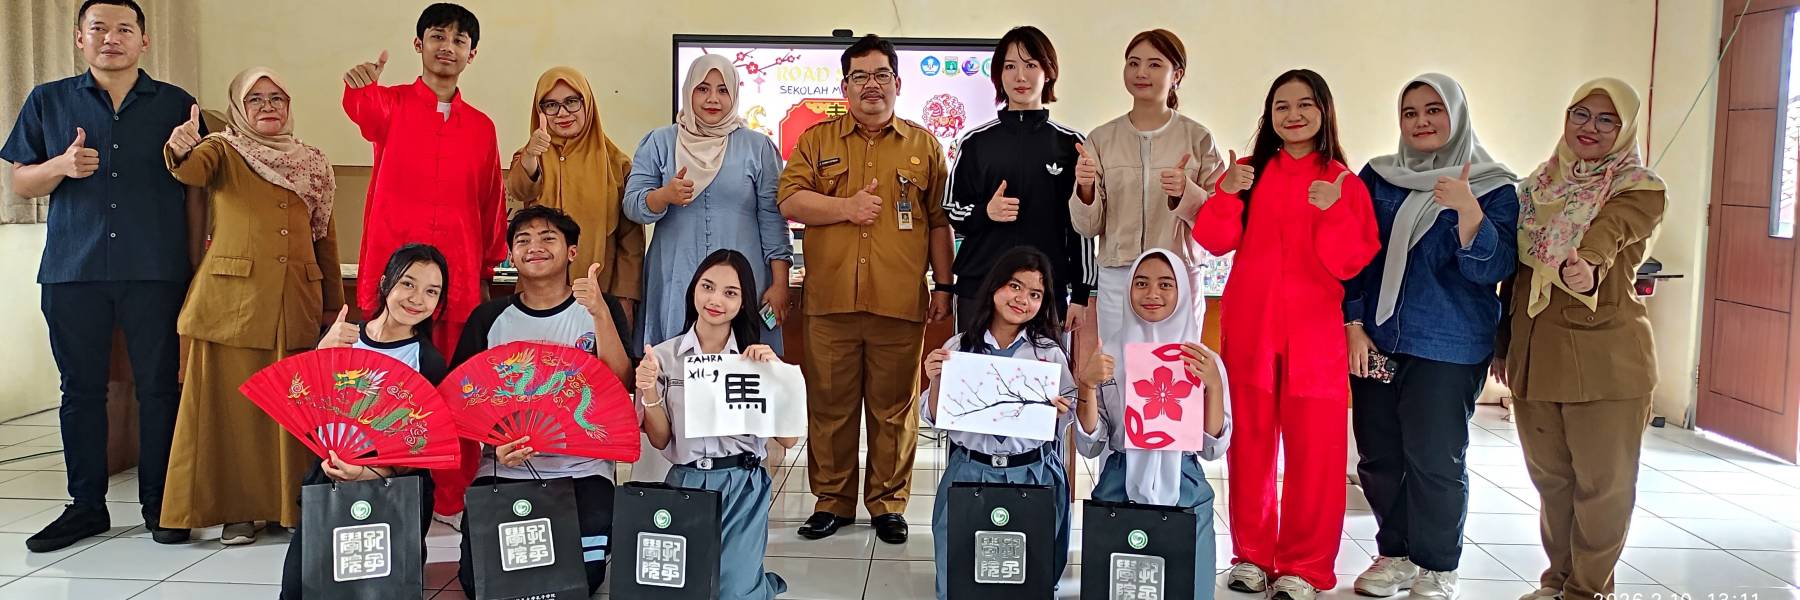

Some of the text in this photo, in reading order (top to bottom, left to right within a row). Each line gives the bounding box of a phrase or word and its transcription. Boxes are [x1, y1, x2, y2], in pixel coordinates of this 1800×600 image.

[776, 65, 831, 81] ROAD
[780, 86, 828, 95] SEKOLAH
[687, 355, 723, 364] ZAHRA
[725, 373, 767, 414] 馬
